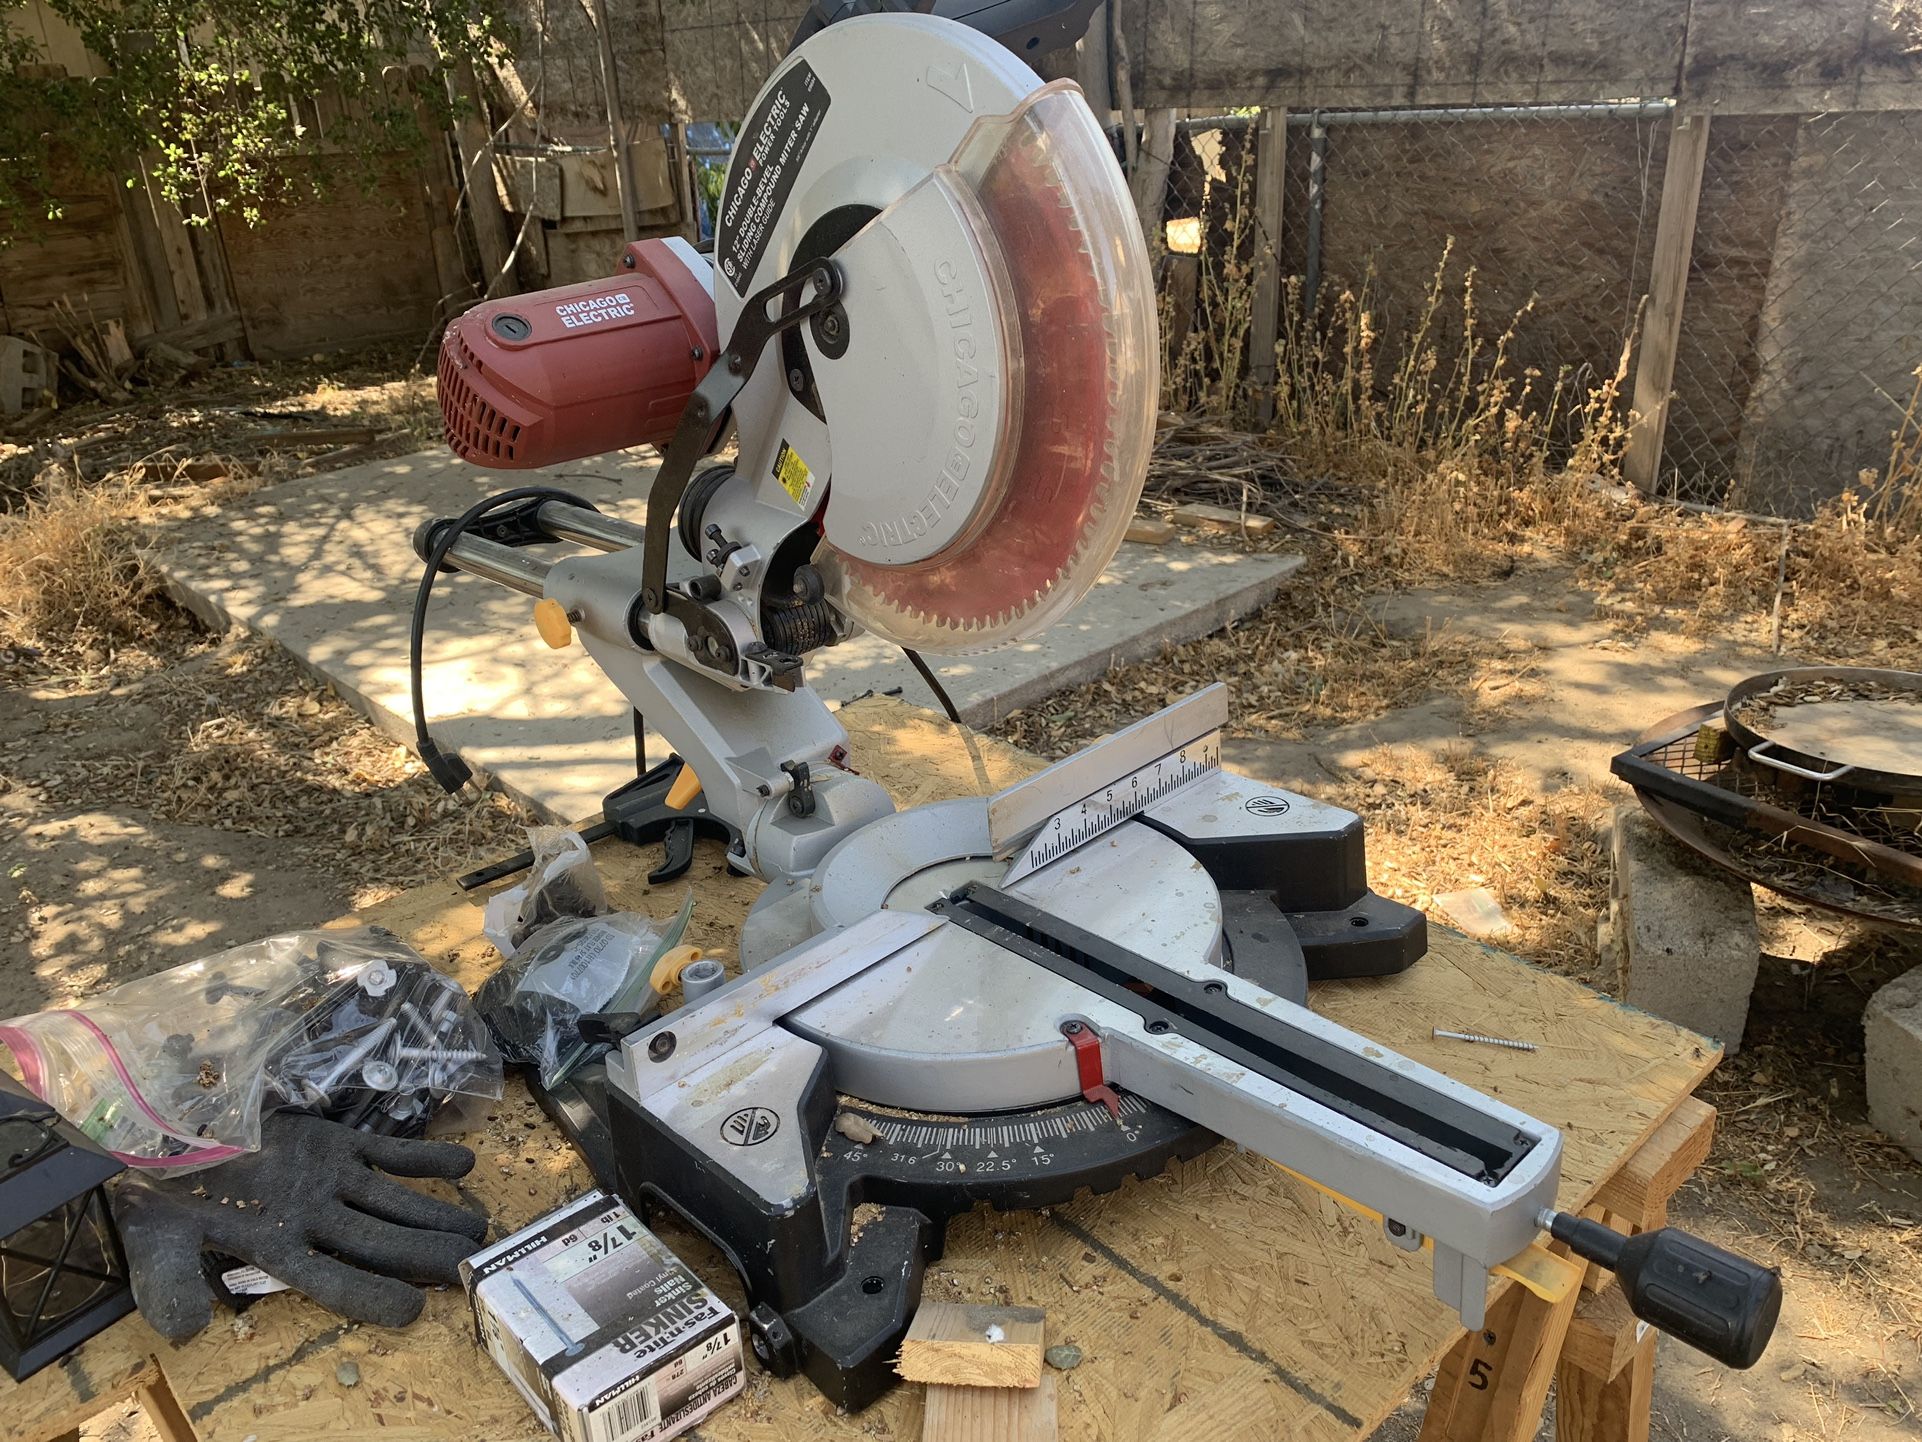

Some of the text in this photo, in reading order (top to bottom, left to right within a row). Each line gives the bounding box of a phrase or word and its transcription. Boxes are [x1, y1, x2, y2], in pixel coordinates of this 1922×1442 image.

[759, 99, 790, 167] POWER TOOLS
[725, 90, 786, 227] CHICAGO ELECTRIC
[737, 223, 757, 263] SLIDING
[754, 164, 782, 224] COMPOUND
[779, 130, 798, 166] MITER
[795, 102, 810, 131] SAW
[739, 164, 773, 235] DOUBLE-BEVEL
[742, 198, 776, 270] WITH LASER GUIDE
[555, 296, 617, 316] CHICAGO
[561, 304, 635, 328] ELECTRIC
[934, 260, 979, 448] CHICAGO
[775, 447, 787, 473] CAUTION
[1054, 817, 1061, 830] 3
[1081, 803, 1087, 815] 4
[1106, 790, 1113, 801] 5
[1131, 776, 1138, 788] 6
[1154, 763, 1162, 775] 7
[1179, 750, 1187, 763] 8
[976, 1158, 1017, 1172] 22.5°
[1031, 1153, 1055, 1166] 15°
[600, 1211, 621, 1224] 1 lb
[483, 1235, 548, 1274] HILLMAN
[561, 1234, 578, 1246] 6d
[626, 1280, 656, 1300] Coated
[653, 1274, 686, 1295] Nails
[654, 1281, 693, 1308] Sinker
[612, 1292, 708, 1354] SINKER
[595, 1374, 640, 1406] HILLMAN
[713, 1375, 738, 1397] CABEZA
[1468, 1358, 1493, 1391] 5
[659, 1393, 711, 1433] ANTIDESLIZANTE
